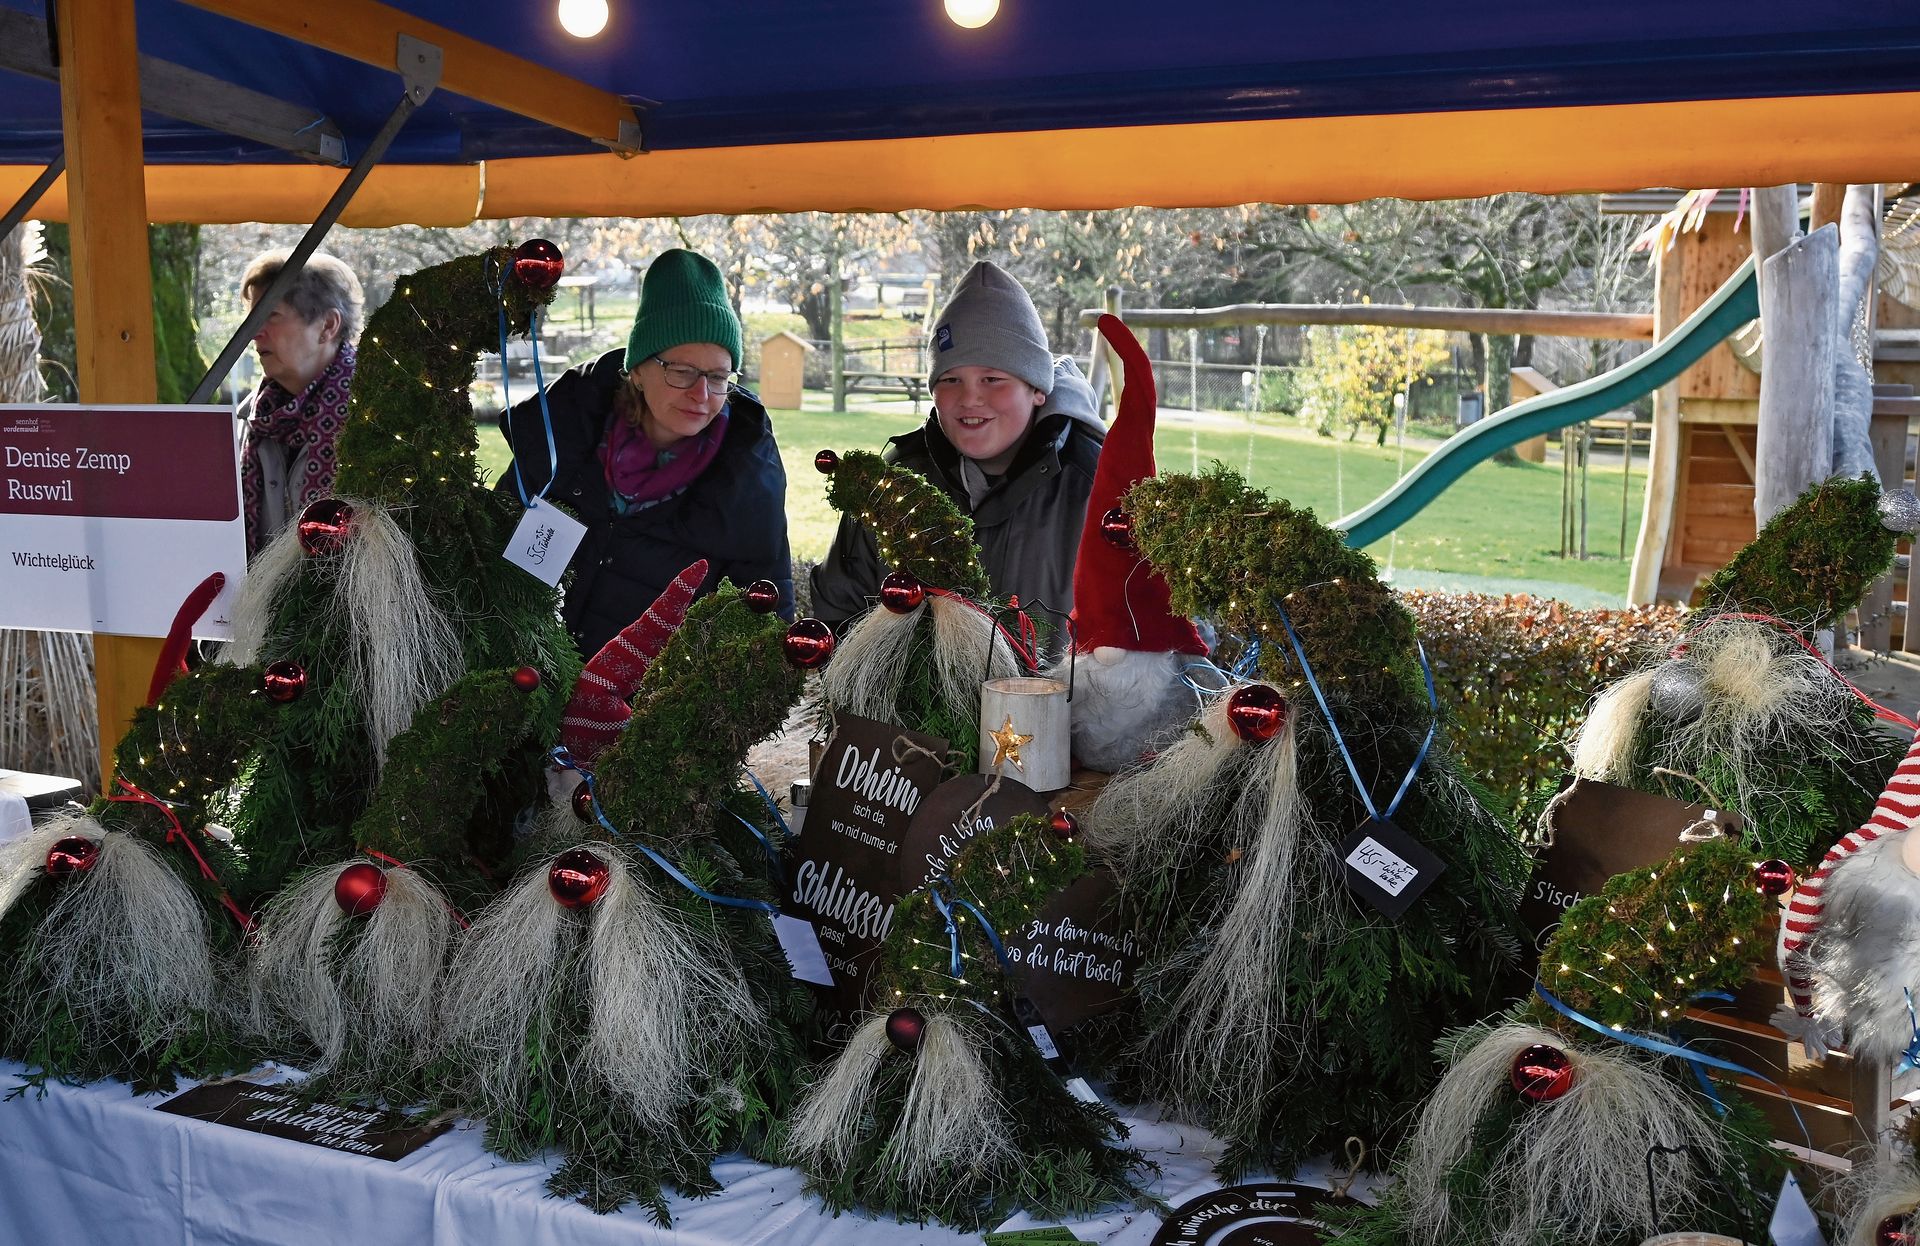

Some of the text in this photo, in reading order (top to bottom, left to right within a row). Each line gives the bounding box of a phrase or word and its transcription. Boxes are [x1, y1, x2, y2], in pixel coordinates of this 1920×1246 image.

[5, 447, 131, 474] Denise Zemp
[8, 479, 73, 501] Ruswil
[12, 552, 95, 571] Wichtelglück
[836, 744, 921, 816] Deheim
[852, 801, 886, 827] isch da,
[831, 819, 898, 855] wo nid nume dr
[939, 835, 960, 857] di
[793, 860, 895, 941] Schlüssu
[819, 925, 846, 947] passt,
[1027, 920, 1050, 940] zu
[1054, 917, 1088, 945] däm
[846, 961, 858, 977] ds
[1026, 943, 1049, 969] du
[1054, 948, 1088, 977] hüt
[1085, 953, 1122, 986] bisch
[1178, 1198, 1288, 1236] wünsche dir
